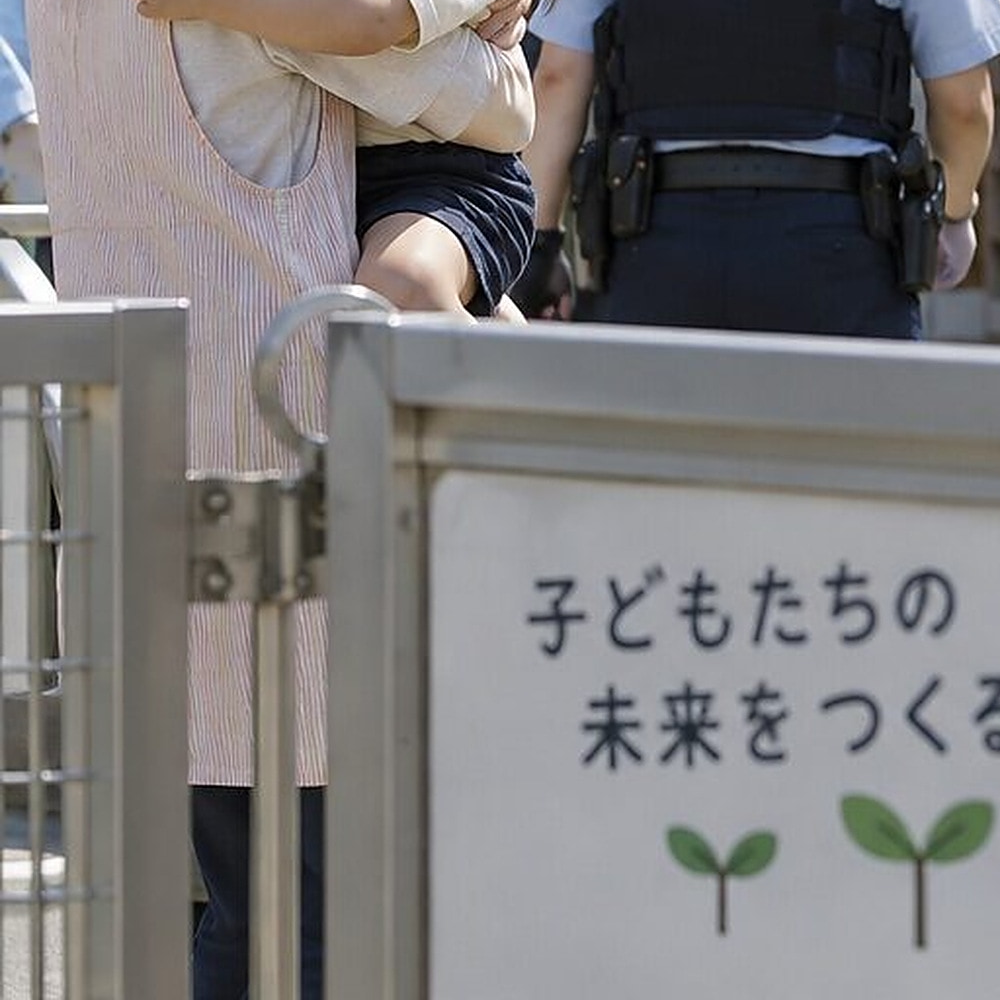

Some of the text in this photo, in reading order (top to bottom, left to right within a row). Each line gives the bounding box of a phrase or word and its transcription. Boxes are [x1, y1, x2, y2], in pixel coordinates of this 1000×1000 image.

[527, 560, 956, 657] 子どもたちの
